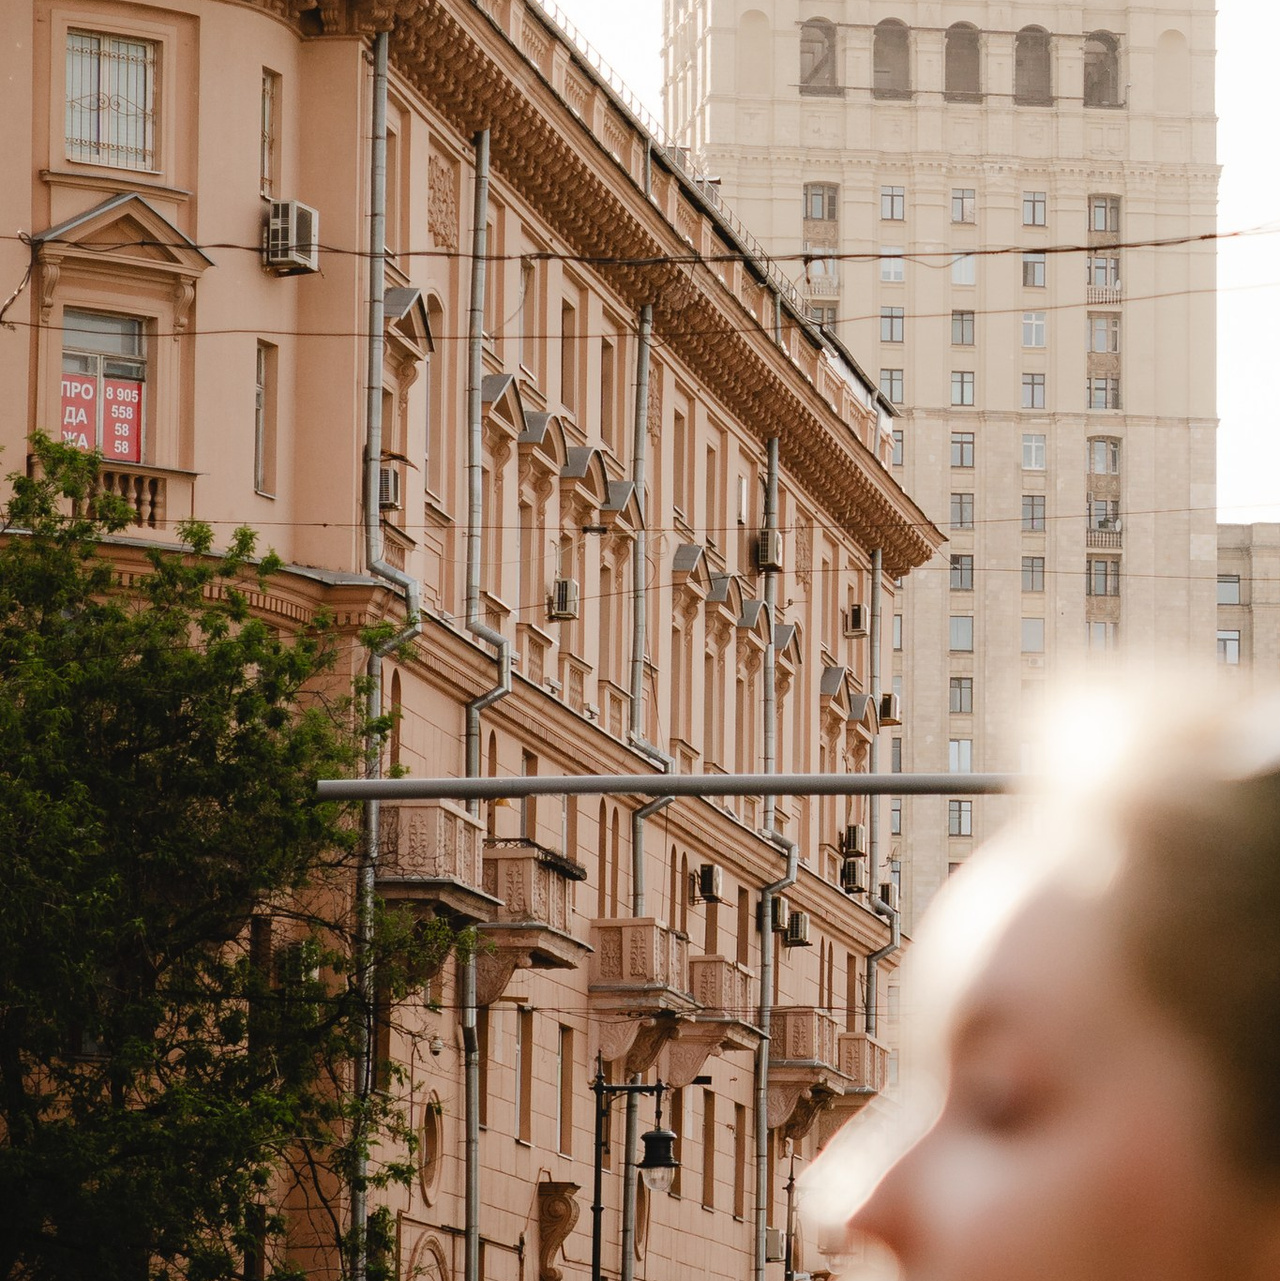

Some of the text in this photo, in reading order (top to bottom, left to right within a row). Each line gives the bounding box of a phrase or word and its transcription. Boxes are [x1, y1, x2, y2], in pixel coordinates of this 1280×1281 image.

[61, 381, 94, 400] ПРО
[106, 387, 139, 403] 8 905
[64, 406, 88, 426] ДА
[111, 405, 133, 419] 558
[114, 422, 129, 436] 58
[62, 431, 89, 449] ЖА
[114, 440, 129, 454] 58
